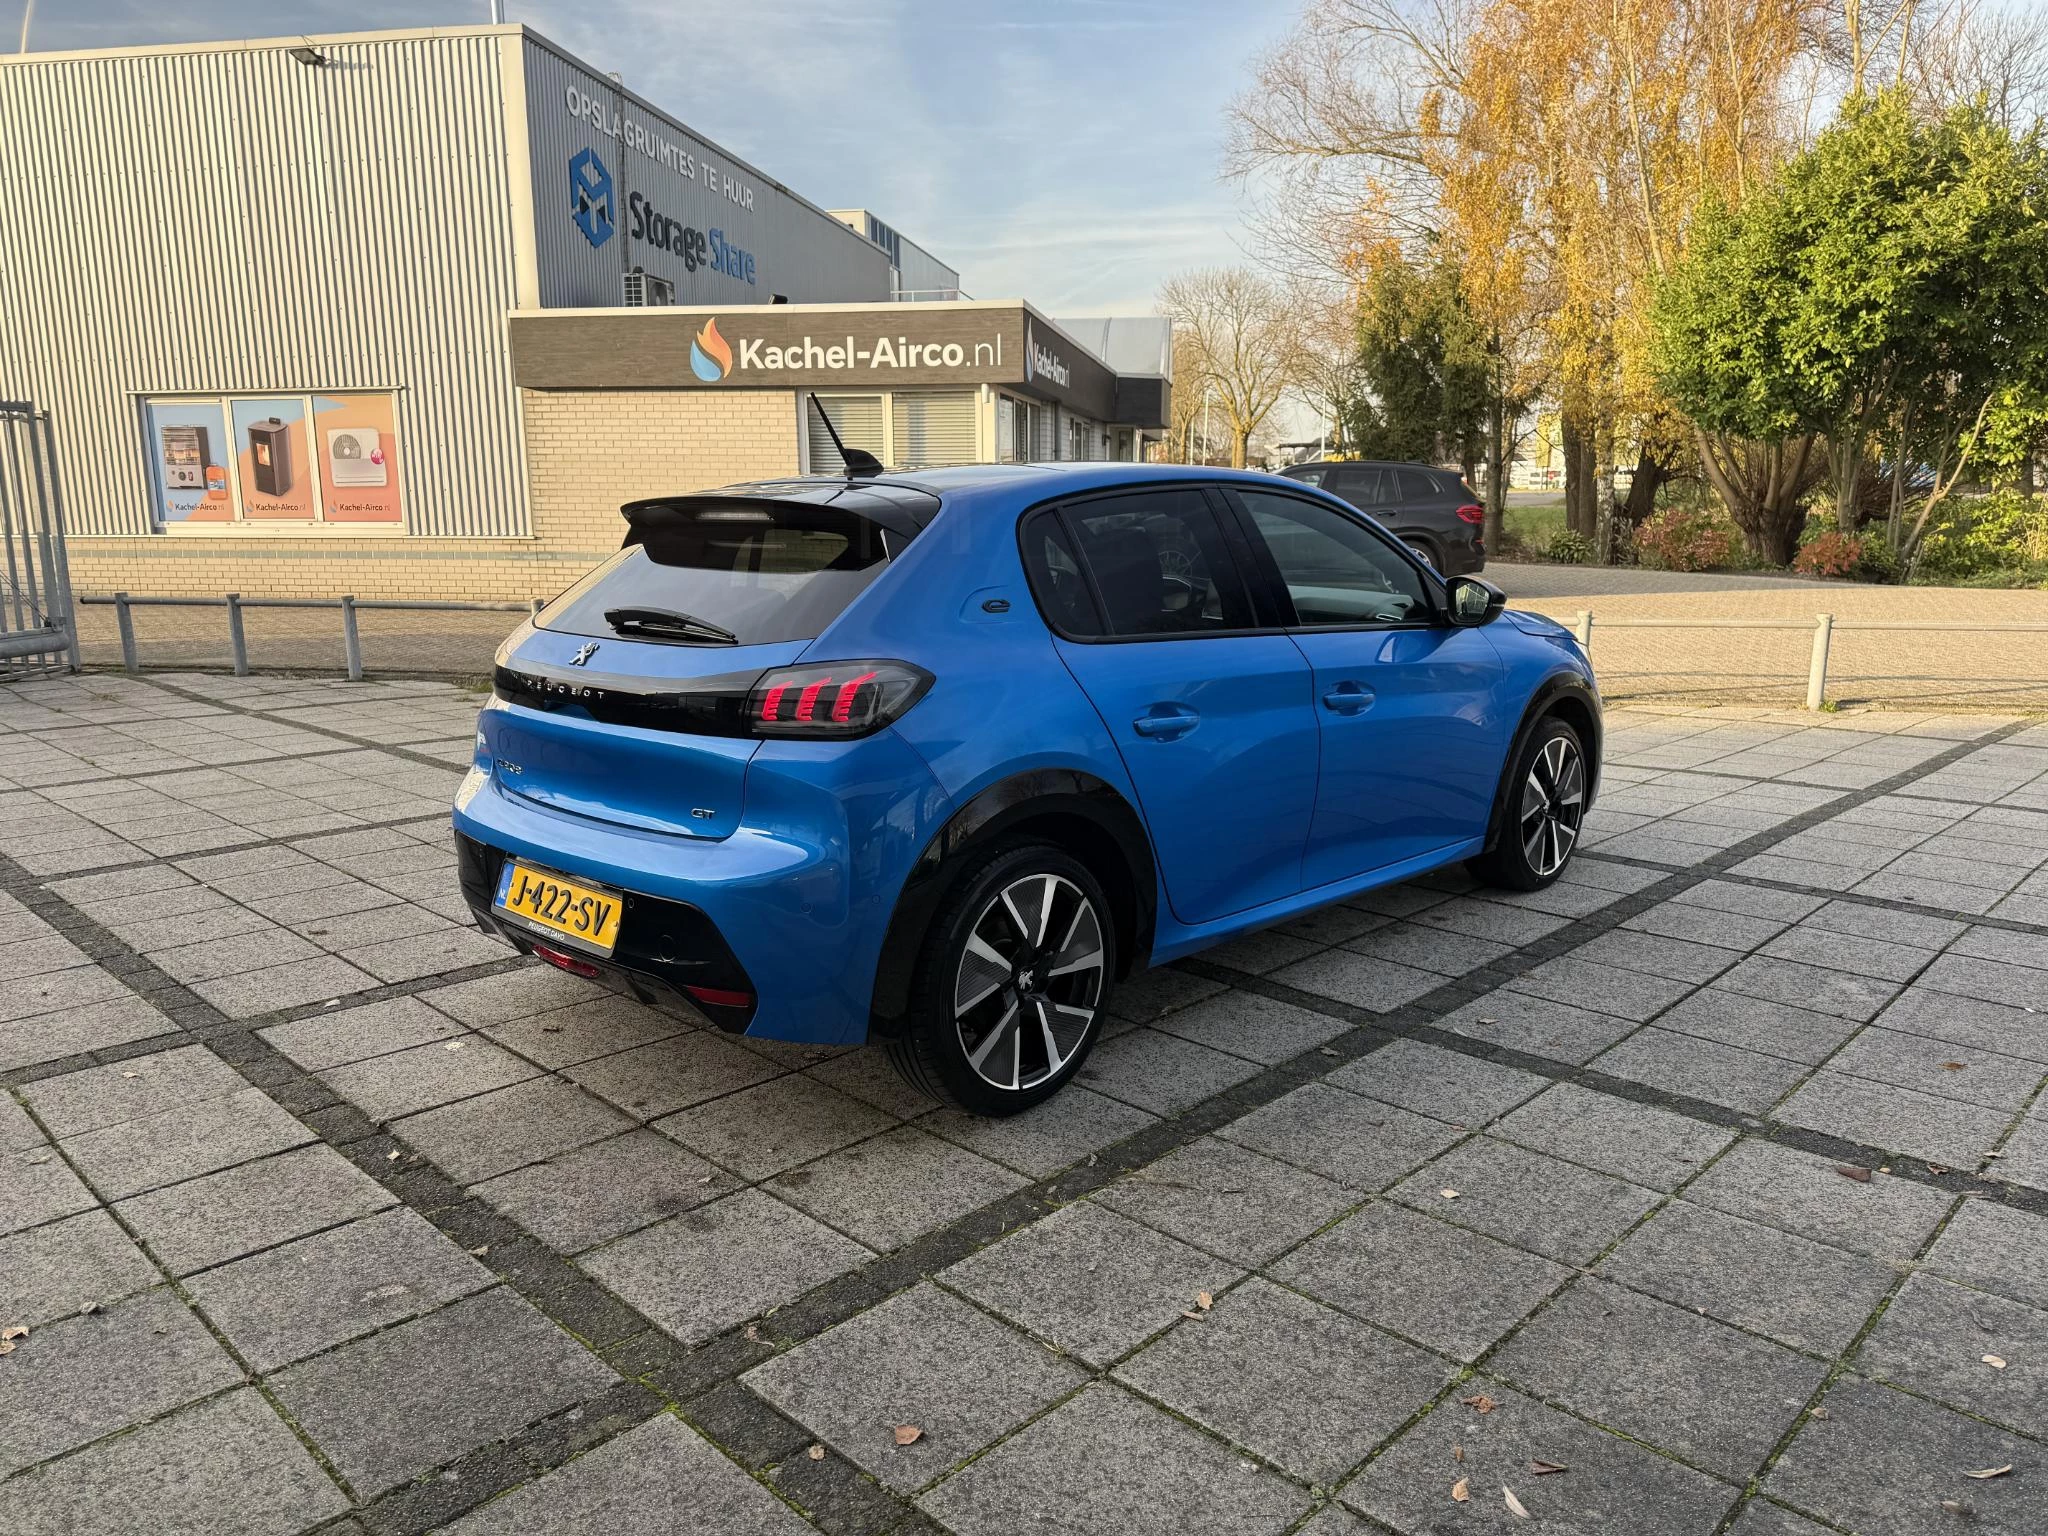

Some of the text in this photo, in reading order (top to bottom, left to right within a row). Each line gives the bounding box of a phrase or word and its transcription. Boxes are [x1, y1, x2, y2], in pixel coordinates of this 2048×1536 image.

[566, 85, 754, 212] OPSLAGRUIMTES TE HUUR
[739, 333, 1001, 369] Kachel-Airco.nl
[527, 680, 604, 699] PEUGEOT
[691, 807, 716, 820] GT
[512, 875, 611, 936] J-422-SV
[527, 921, 551, 935] PEUGEOT
